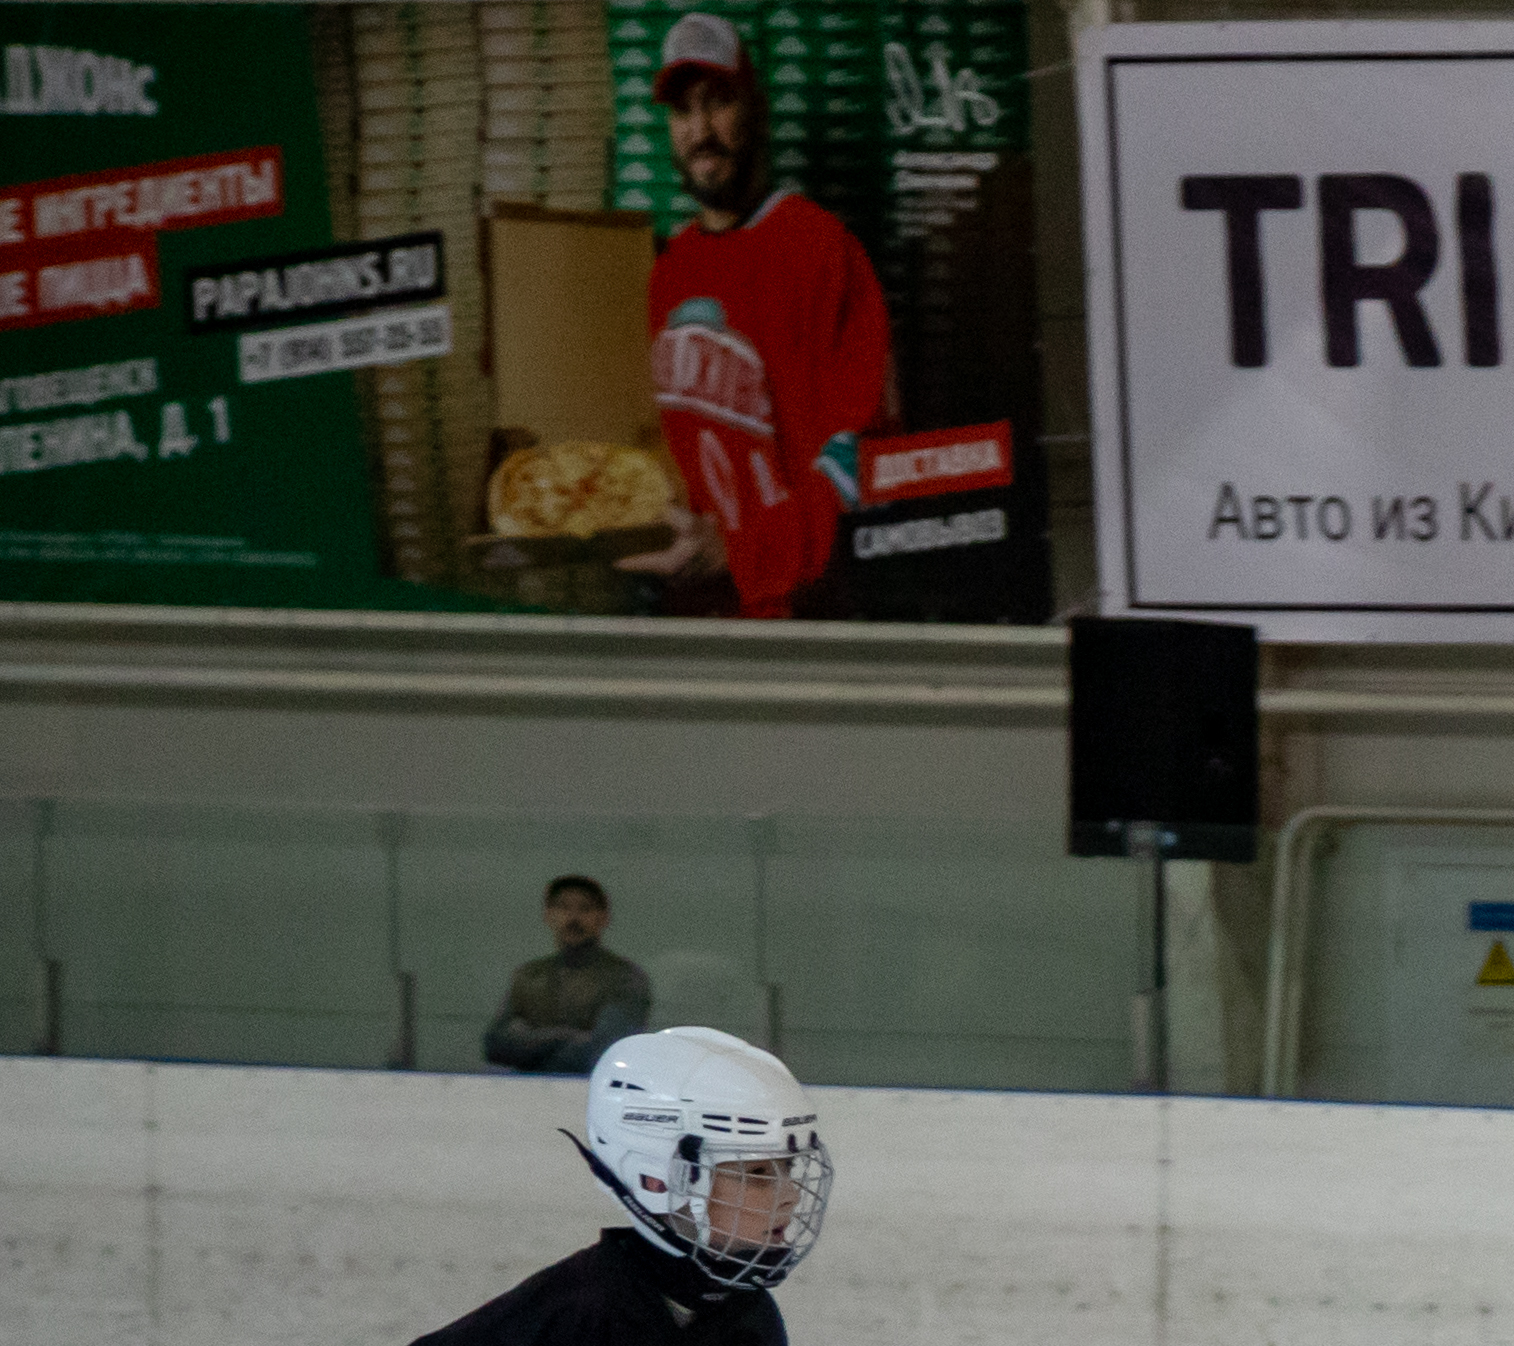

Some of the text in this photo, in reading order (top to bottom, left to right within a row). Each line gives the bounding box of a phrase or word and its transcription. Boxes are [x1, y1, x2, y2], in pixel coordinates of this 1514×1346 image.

[207, 396, 230, 442] 1
[1208, 482, 1352, 541] Авто
[1373, 496, 1439, 541] из
